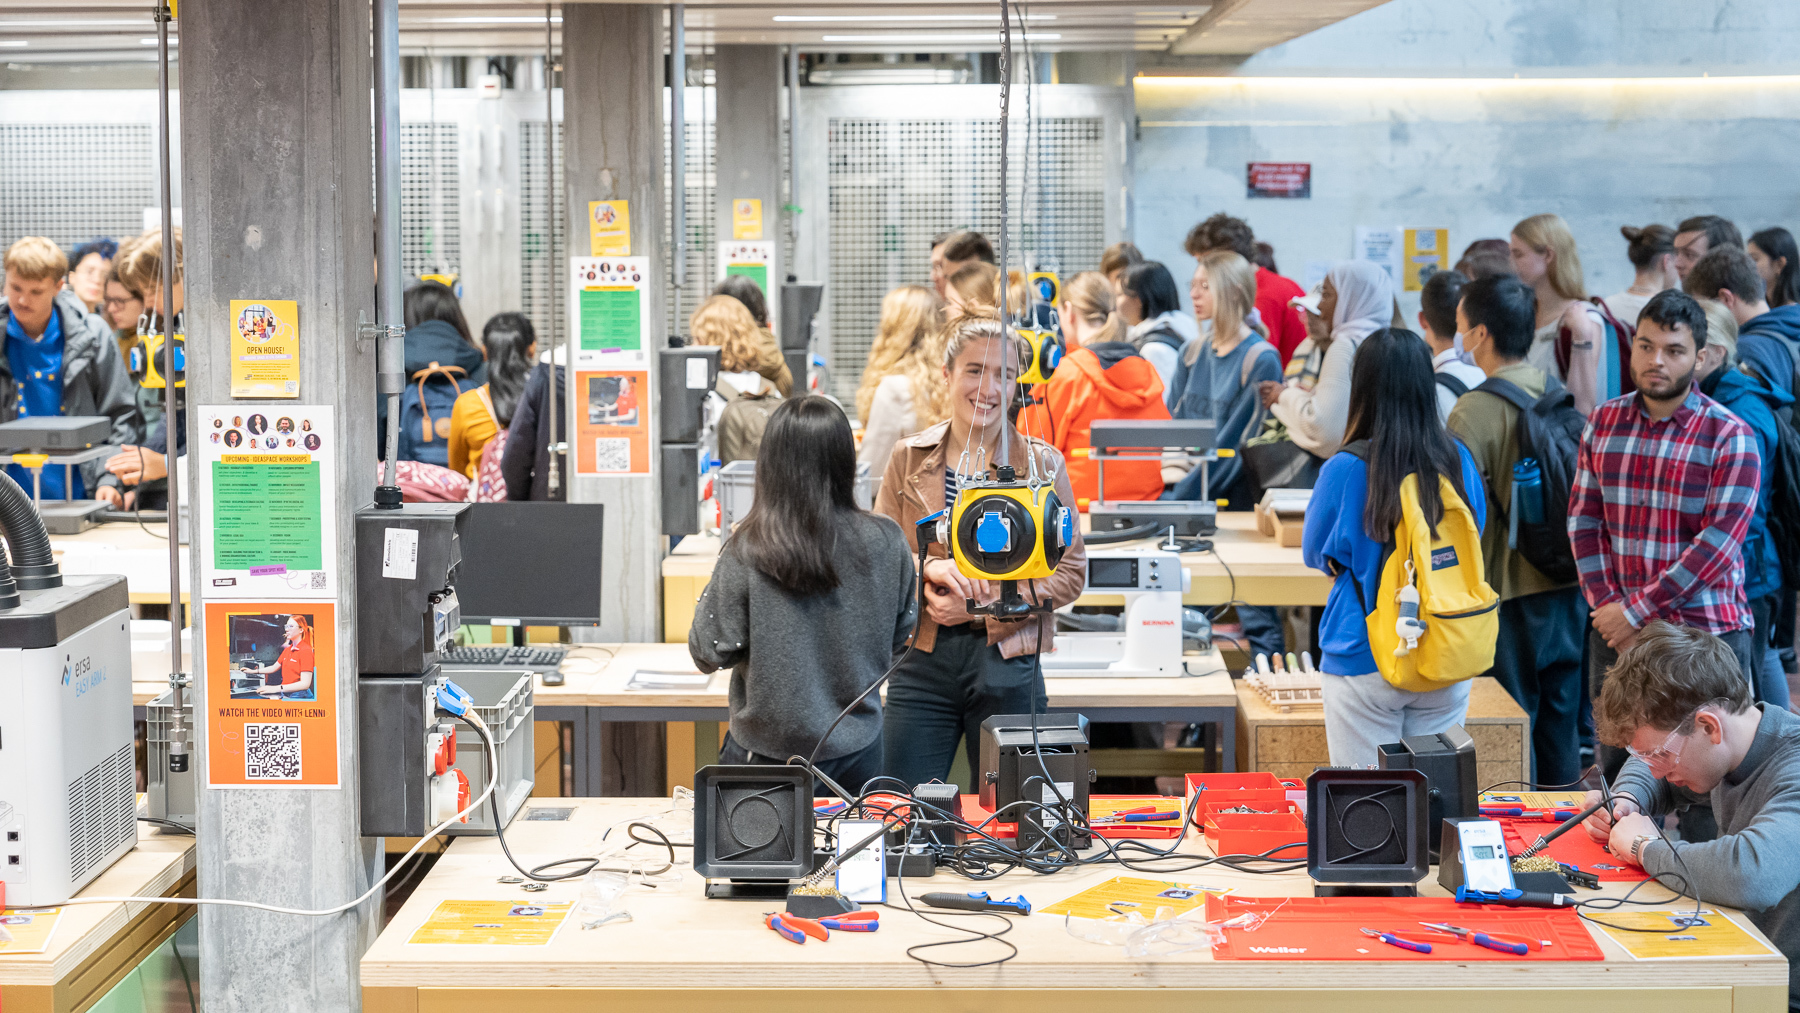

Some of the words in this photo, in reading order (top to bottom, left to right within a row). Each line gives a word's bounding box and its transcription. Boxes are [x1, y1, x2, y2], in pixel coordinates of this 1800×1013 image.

[246, 346, 262, 354] OPEN
[263, 346, 285, 354] HOUSE!
[75, 656, 91, 678] ersa
[75, 676, 89, 698] EASY
[90, 668, 102, 688] ARM
[218, 708, 244, 717] WATCH
[247, 708, 259, 717] THE
[262, 708, 283, 717] VIDEO
[285, 708, 302, 717] WITH
[304, 709, 326, 718] LENNI
[1248, 946, 1308, 954] Weller
